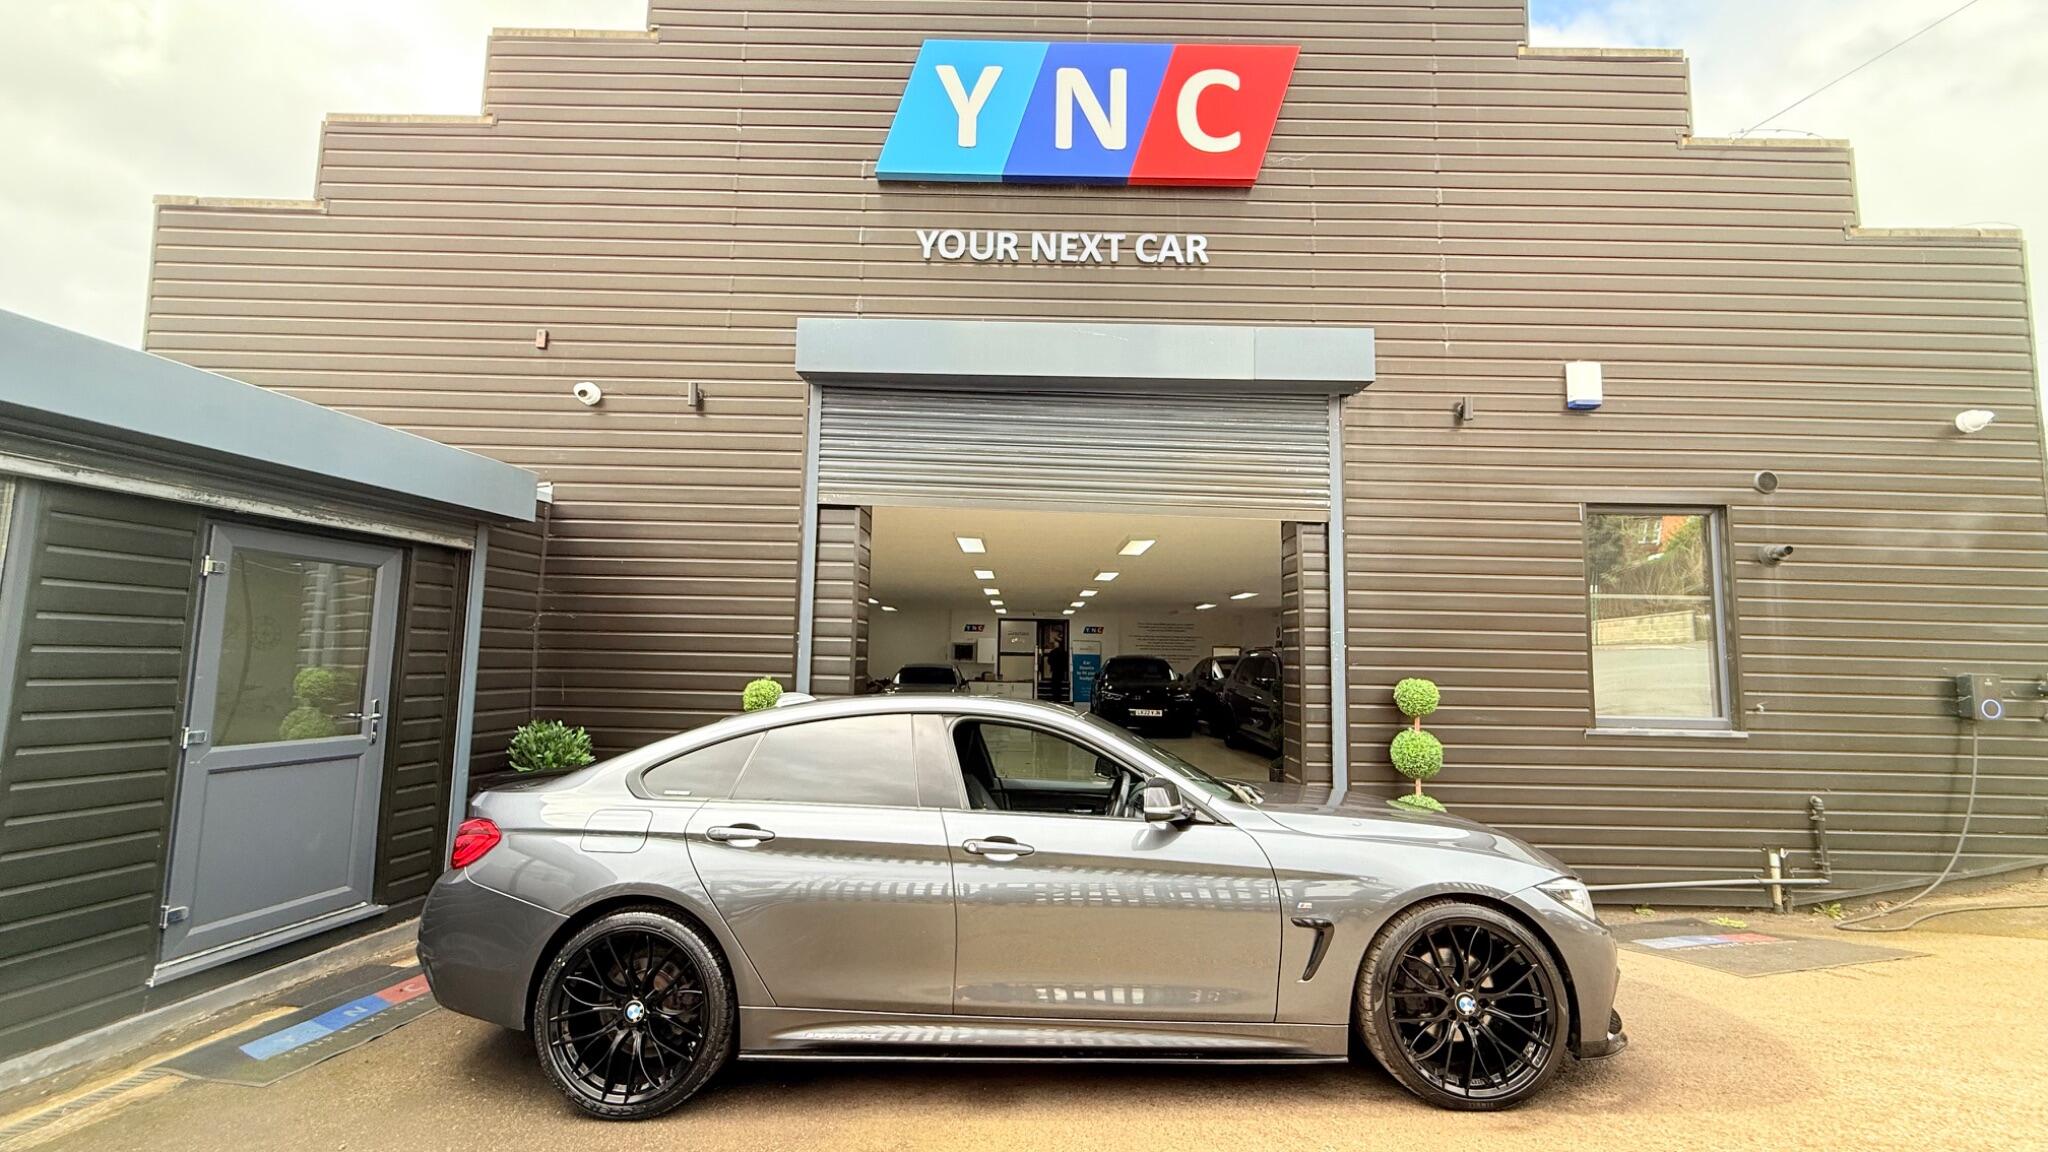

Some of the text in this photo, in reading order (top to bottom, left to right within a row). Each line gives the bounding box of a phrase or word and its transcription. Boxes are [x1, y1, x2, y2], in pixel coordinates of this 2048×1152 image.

[935, 65, 1241, 152] YNC
[916, 229, 1209, 264] YOUR NEXT CAR
